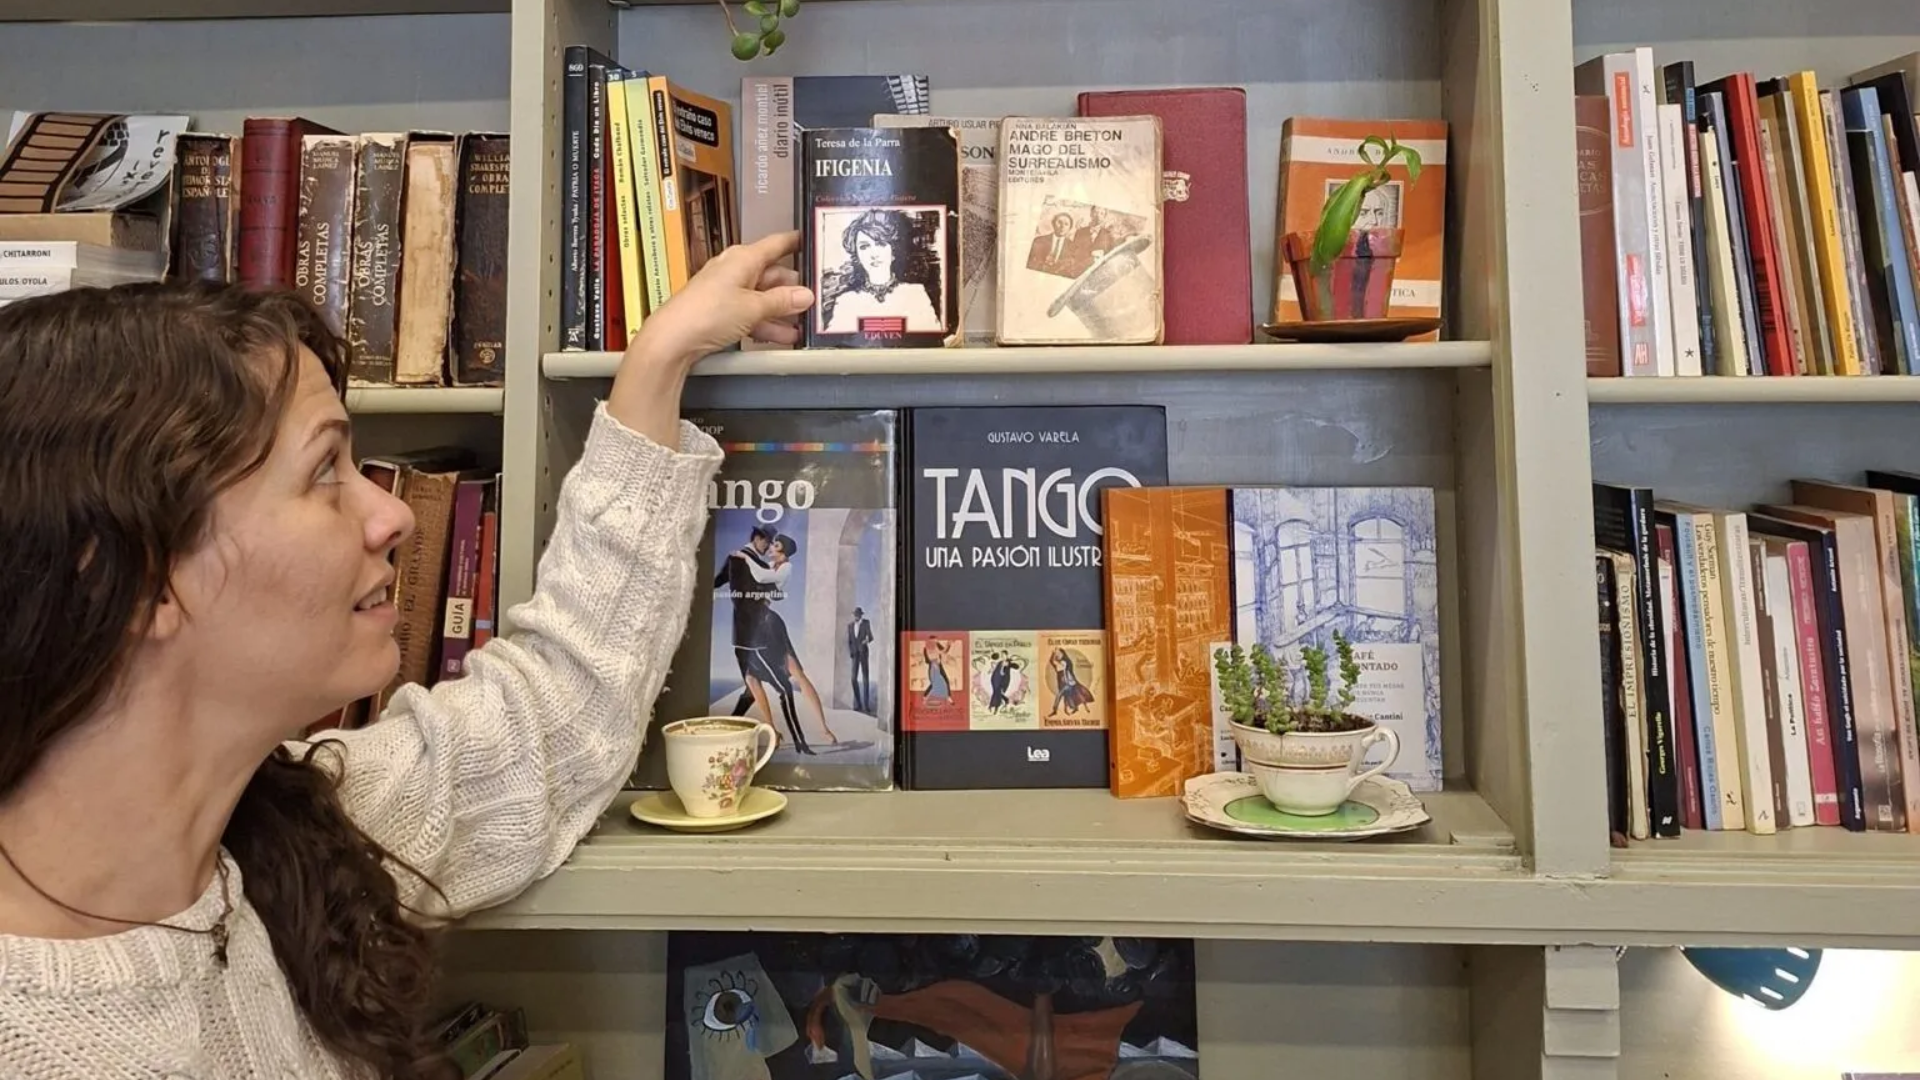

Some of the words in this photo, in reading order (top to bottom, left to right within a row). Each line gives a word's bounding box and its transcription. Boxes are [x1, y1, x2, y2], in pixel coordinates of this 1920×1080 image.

[594, 106, 600, 116] un
[758, 83, 768, 126] montiel
[774, 84, 788, 119] inútil
[928, 120, 960, 128] ARTURO
[962, 120, 988, 128] USLAR
[1010, 130, 1058, 142] ANDRE
[1064, 130, 1122, 142] BRETON
[614, 122, 622, 156] Chalbaud
[636, 120, 647, 154] Garmendia
[758, 130, 768, 155] añez
[774, 123, 788, 158] diario
[815, 138, 846, 148] Teresa
[848, 138, 860, 148] de
[864, 138, 872, 147] la
[875, 138, 901, 148] Parra
[474, 154, 510, 162] WILLIA
[960, 146, 995, 159] SON
[1009, 144, 1054, 156] MAGO
[1058, 144, 1086, 156] DEL
[1327, 148, 1356, 156] ANDR
[470, 163, 510, 172] SHAKESPE
[616, 158, 625, 183] Román
[641, 157, 649, 186] Salvador
[816, 158, 893, 177] IFIGENIA
[1008, 156, 1111, 170] SURREALISMO
[1648, 152, 1656, 178] Gelman
[482, 174, 510, 182] OBRA
[758, 158, 768, 194] ricardo
[470, 184, 510, 194] COMPLET
[620, 195, 628, 224] selectas
[622, 227, 630, 248] Obras
[4, 250, 51, 258] CHITARRONI
[297, 240, 310, 287] OBRAS
[313, 222, 330, 306] COMPLETAS
[358, 241, 372, 288] OBRAS
[372, 224, 390, 306] COMPLETAS
[0, 278, 19, 286] ULOS
[22, 278, 47, 286] OYOLA
[593, 278, 601, 300] Valle
[1392, 288, 1416, 298] TICA
[593, 305, 601, 339] Gustavo
[864, 332, 903, 340] EDUVEN
[987, 430, 1034, 444] GUSTAVO
[1038, 431, 1080, 444] VARELA
[707, 479, 815, 524] ango
[923, 467, 1144, 540] TANGO
[1639, 508, 1649, 535] gordura
[1695, 524, 1704, 540] Los
[1703, 523, 1712, 543] Guy
[408, 528, 424, 586] GRANDE
[926, 547, 964, 570] UNA
[972, 544, 1040, 569] PASIÓN
[1048, 546, 1103, 569] ILUSTR
[1641, 544, 1648, 552] de
[1827, 548, 1835, 567] Artaud
[1688, 570, 1696, 578] el
[1698, 542, 1710, 588] verdaderos
[1707, 545, 1717, 580] Sorman
[1642, 553, 1653, 598] Metamorfosis
[1830, 569, 1838, 592] Antonin
[404, 594, 416, 612] EL
[713, 590, 743, 600] pasión
[744, 590, 788, 600] argentina
[452, 602, 464, 634] GUÍA
[1700, 590, 1713, 636] pensadores
[1619, 584, 1636, 697] IMPRESIONISMO
[1649, 640, 1656, 649] de
[1707, 639, 1715, 648] de
[1835, 630, 1844, 656] sociedad
[1354, 650, 1375, 660] AFÉ
[1357, 662, 1398, 671] NTADO
[1650, 651, 1659, 676] Historia
[1708, 650, 1717, 682] nuestro
[1804, 637, 1820, 692] Zaratustra
[1840, 665, 1848, 675] por
[1710, 684, 1721, 715] tiempo
[1840, 676, 1849, 704] suicidado
[1374, 712, 1404, 720] Cantini
[1628, 702, 1637, 718] EL
[1786, 693, 1796, 724] Política
[1809, 695, 1823, 724] habló
[1842, 713, 1852, 729] Gogh
[1654, 711, 1664, 744] Vigarello
[1702, 726, 1712, 754] Carlos
[1790, 726, 1797, 735] La
[1026, 746, 1050, 762] Lea
[1658, 746, 1666, 774] Georges
[1872, 732, 1884, 764] filosofía
[1705, 758, 1715, 783] Rojas
